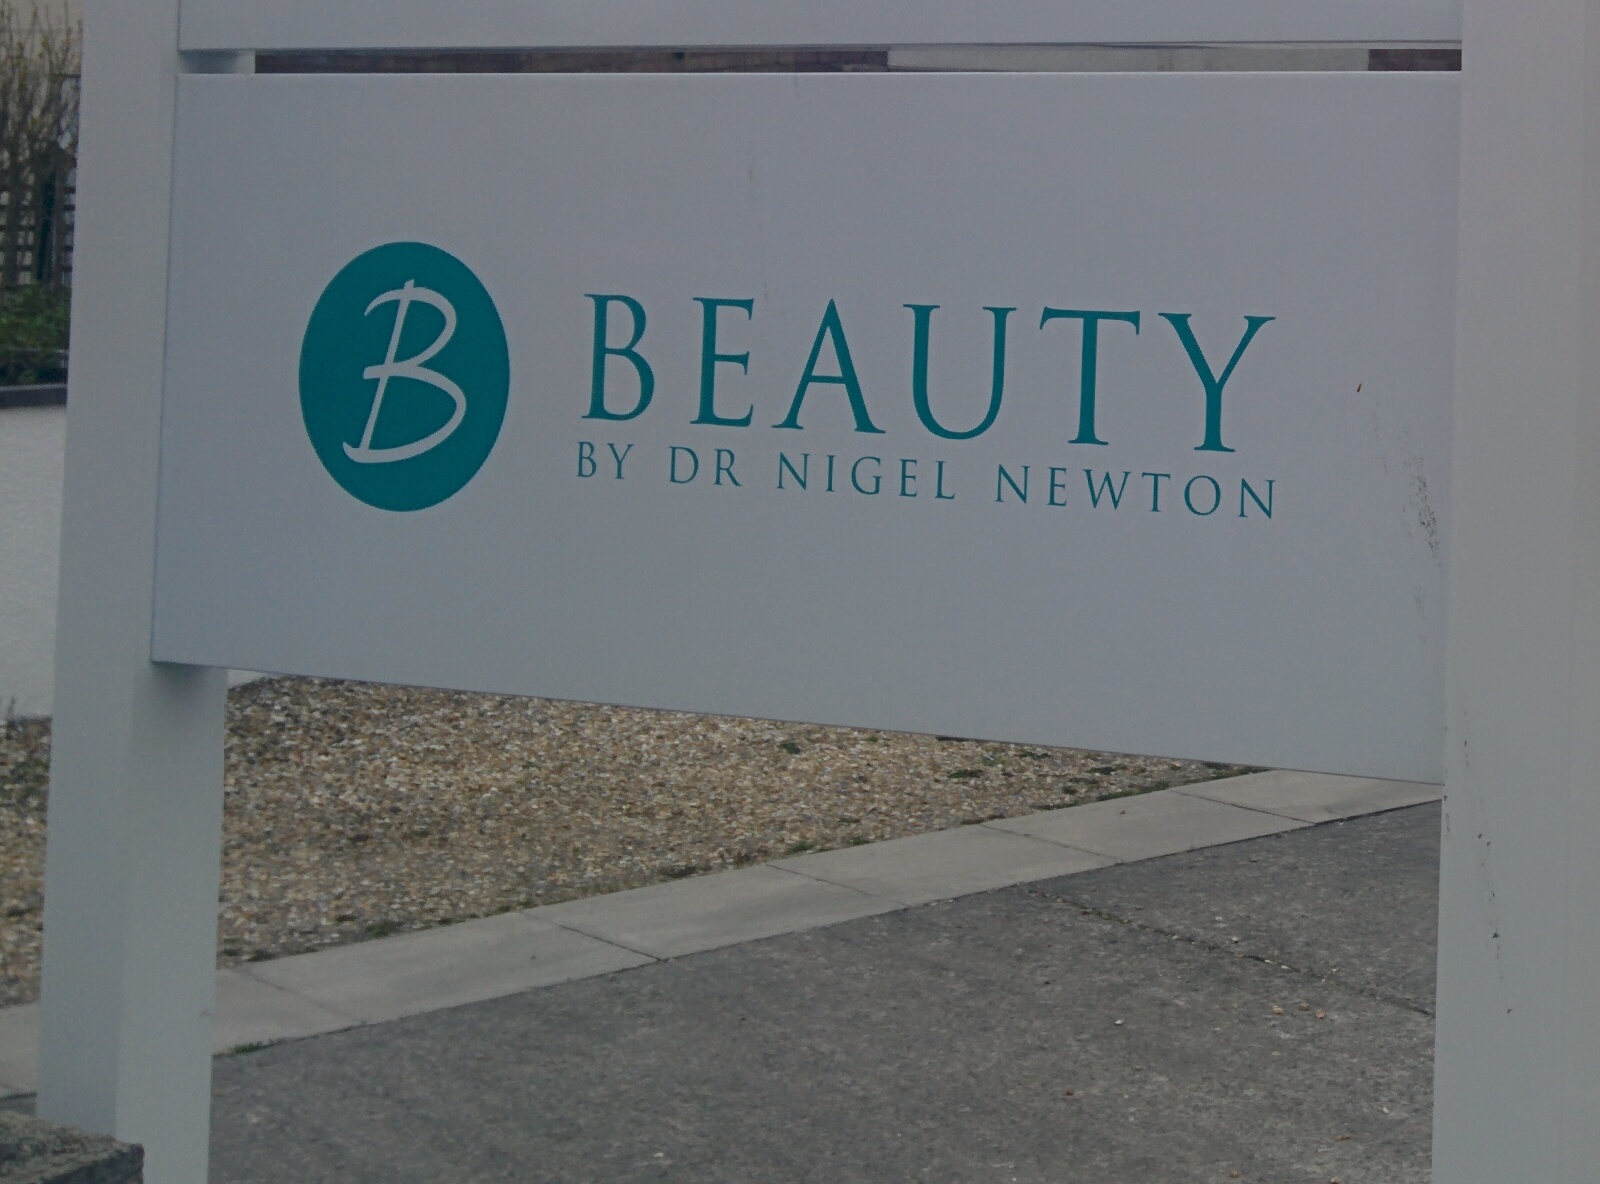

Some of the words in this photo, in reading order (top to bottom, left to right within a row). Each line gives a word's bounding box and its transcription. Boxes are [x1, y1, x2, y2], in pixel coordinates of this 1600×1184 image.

[343, 279, 467, 464] B
[581, 293, 1276, 453] BEAUTY
[576, 441, 634, 479] BY
[669, 446, 742, 487] DR
[777, 452, 956, 500] NIGEL
[995, 464, 1276, 519] NEWTON
